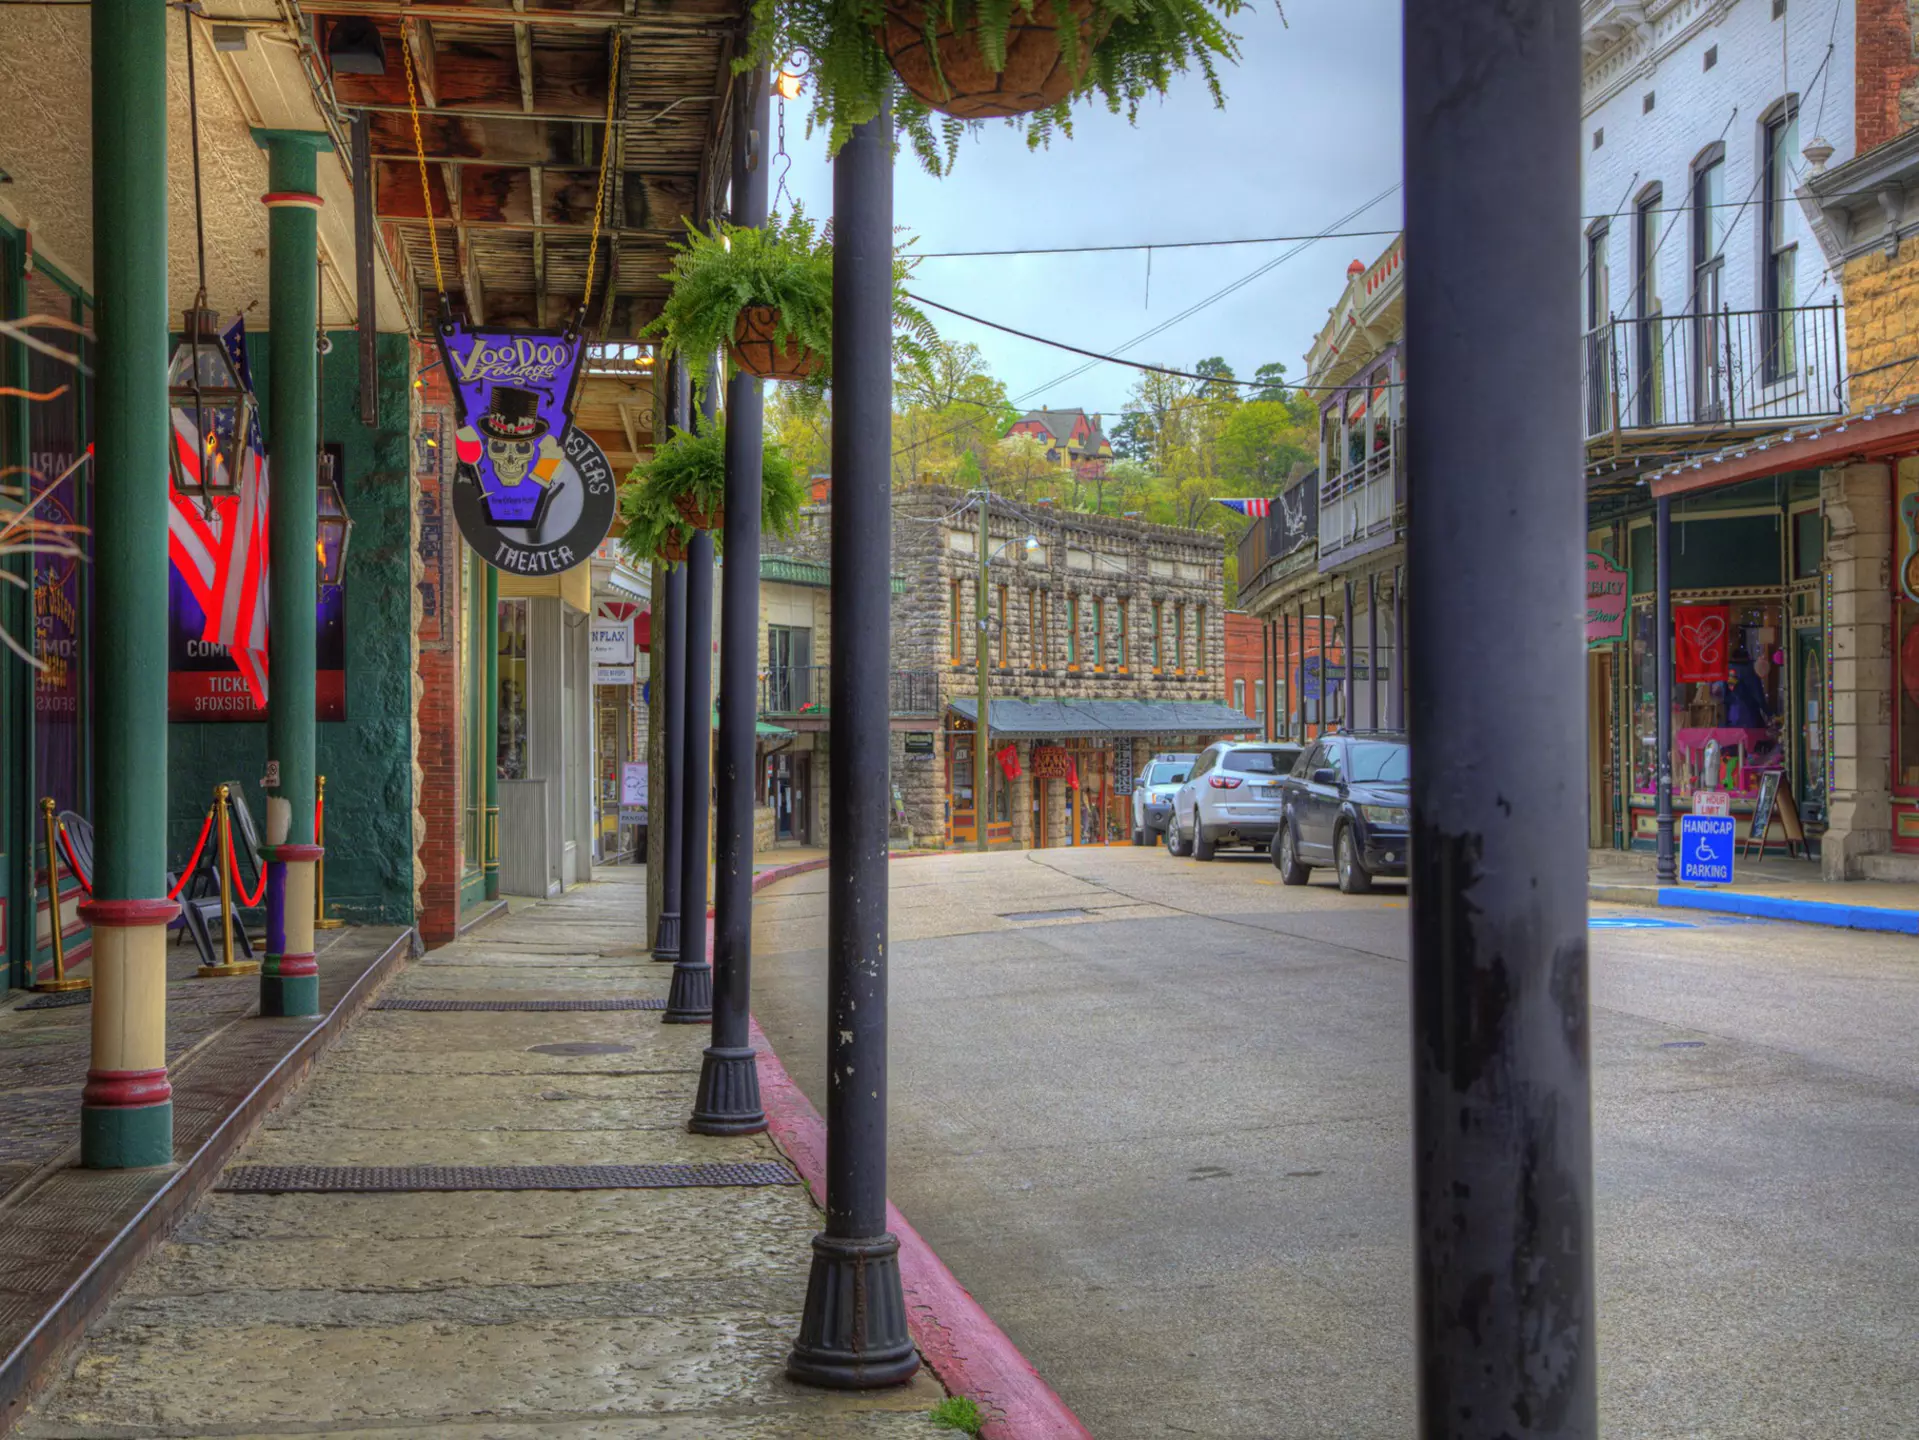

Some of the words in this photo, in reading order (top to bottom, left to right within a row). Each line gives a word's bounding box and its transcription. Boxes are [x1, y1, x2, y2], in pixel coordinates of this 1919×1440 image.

[451, 338, 565, 380] VooDoo
[460, 361, 556, 385] Lounge
[495, 540, 575, 571] THEATER
[1706, 795, 1725, 805] HOUR
[1701, 805, 1720, 815] LIMIT
[1684, 819, 1733, 835] HANDICAP
[1686, 863, 1728, 879] PARKING
